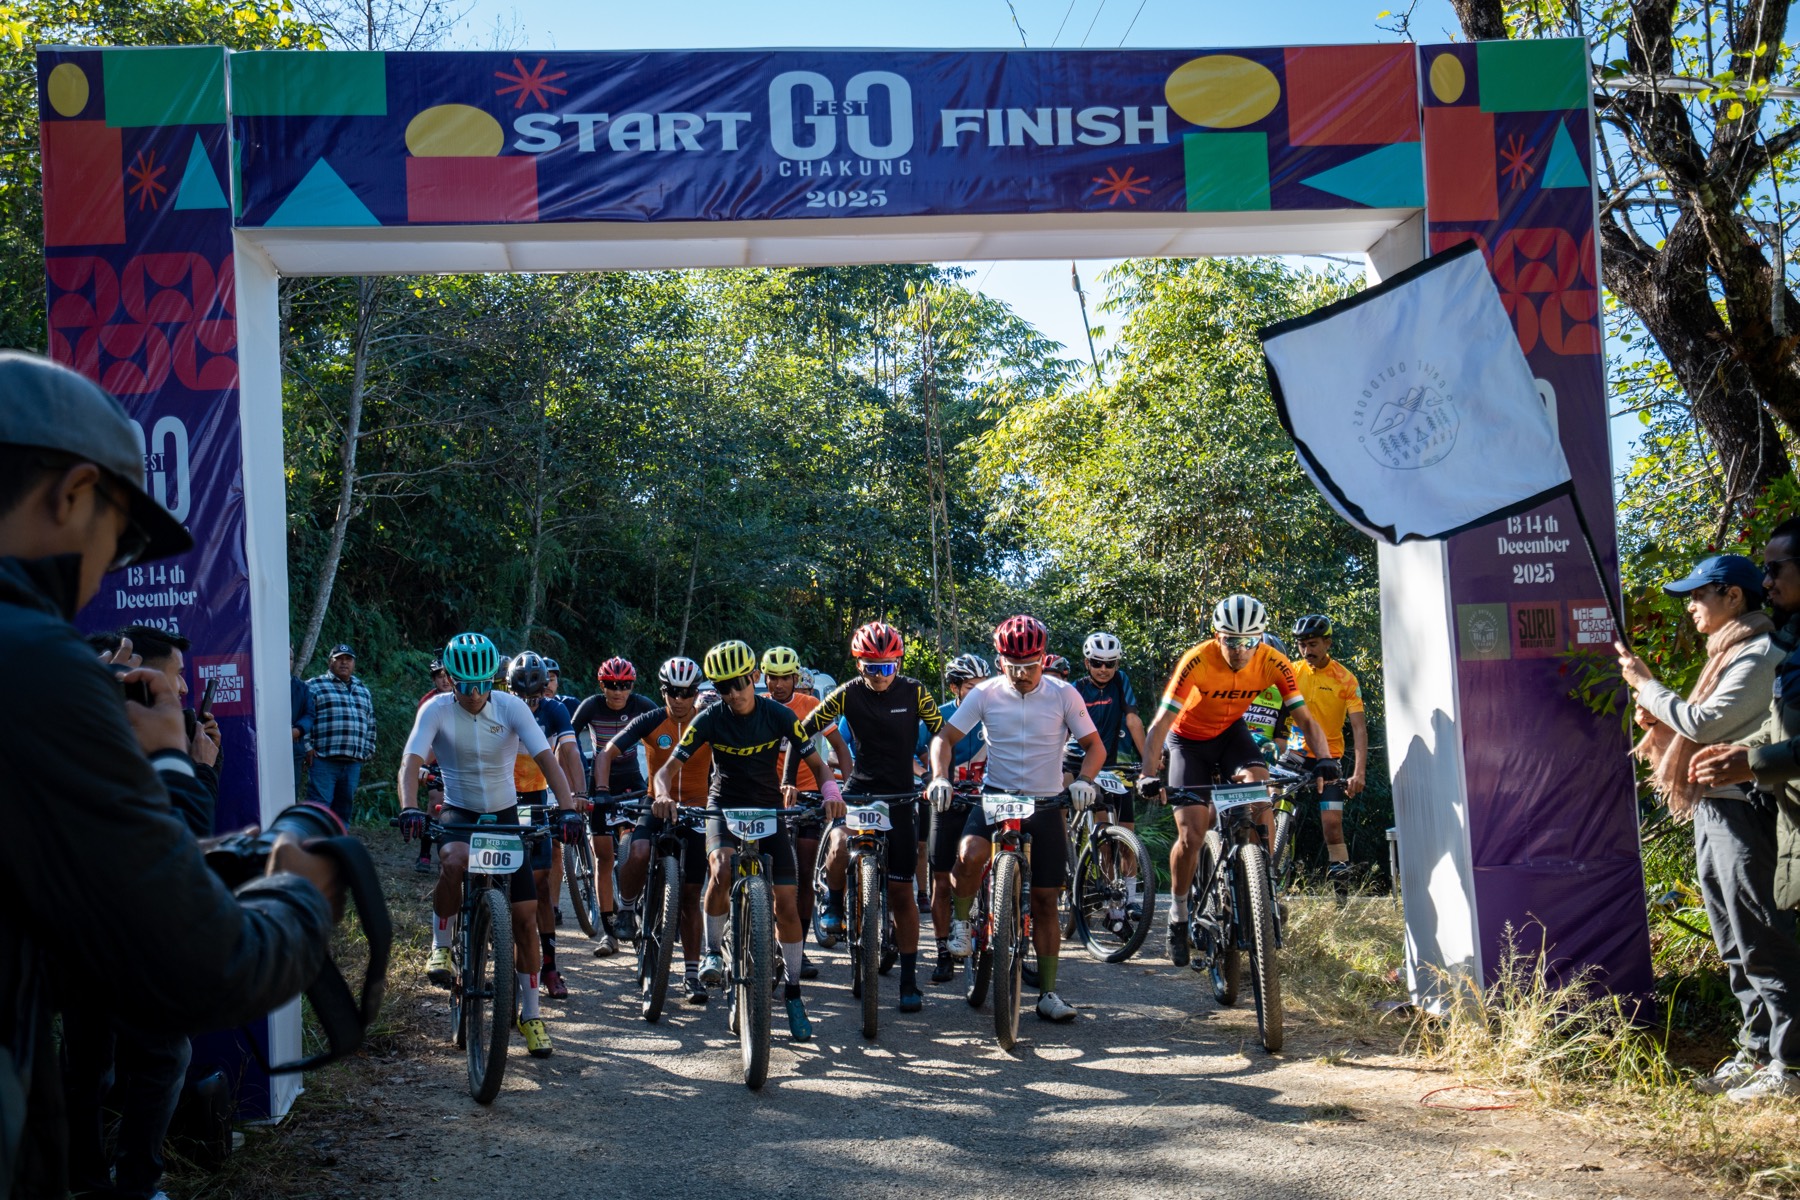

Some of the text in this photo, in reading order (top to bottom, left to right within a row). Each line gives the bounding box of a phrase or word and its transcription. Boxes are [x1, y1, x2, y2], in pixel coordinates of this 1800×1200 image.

[769, 71, 914, 160] GO
[814, 101, 868, 115] FEST
[512, 112, 752, 153] START
[940, 106, 1170, 148] FINISH
[779, 160, 912, 177] CHAKUNG
[806, 190, 888, 208] 2025
[129, 415, 190, 524] O
[142, 453, 165, 472] EST
[1507, 515, 1559, 534] 13-14 th
[1497, 536, 1570, 555] December
[127, 564, 186, 587] 13-14 th
[1513, 563, 1555, 584] 2025
[116, 587, 198, 610] December
[1574, 608, 1593, 620] THE
[1517, 608, 1556, 639] SURU
[1580, 619, 1612, 632] CRASH
[1589, 632, 1608, 643] PAD
[201, 665, 222, 678] THE
[216, 690, 237, 702] PAD
[713, 739, 779, 756] SCOTT
[1100, 778, 1118, 790] 017
[859, 812, 882, 825] 002
[486, 838, 500, 846] MTB
[482, 851, 512, 867] 006
